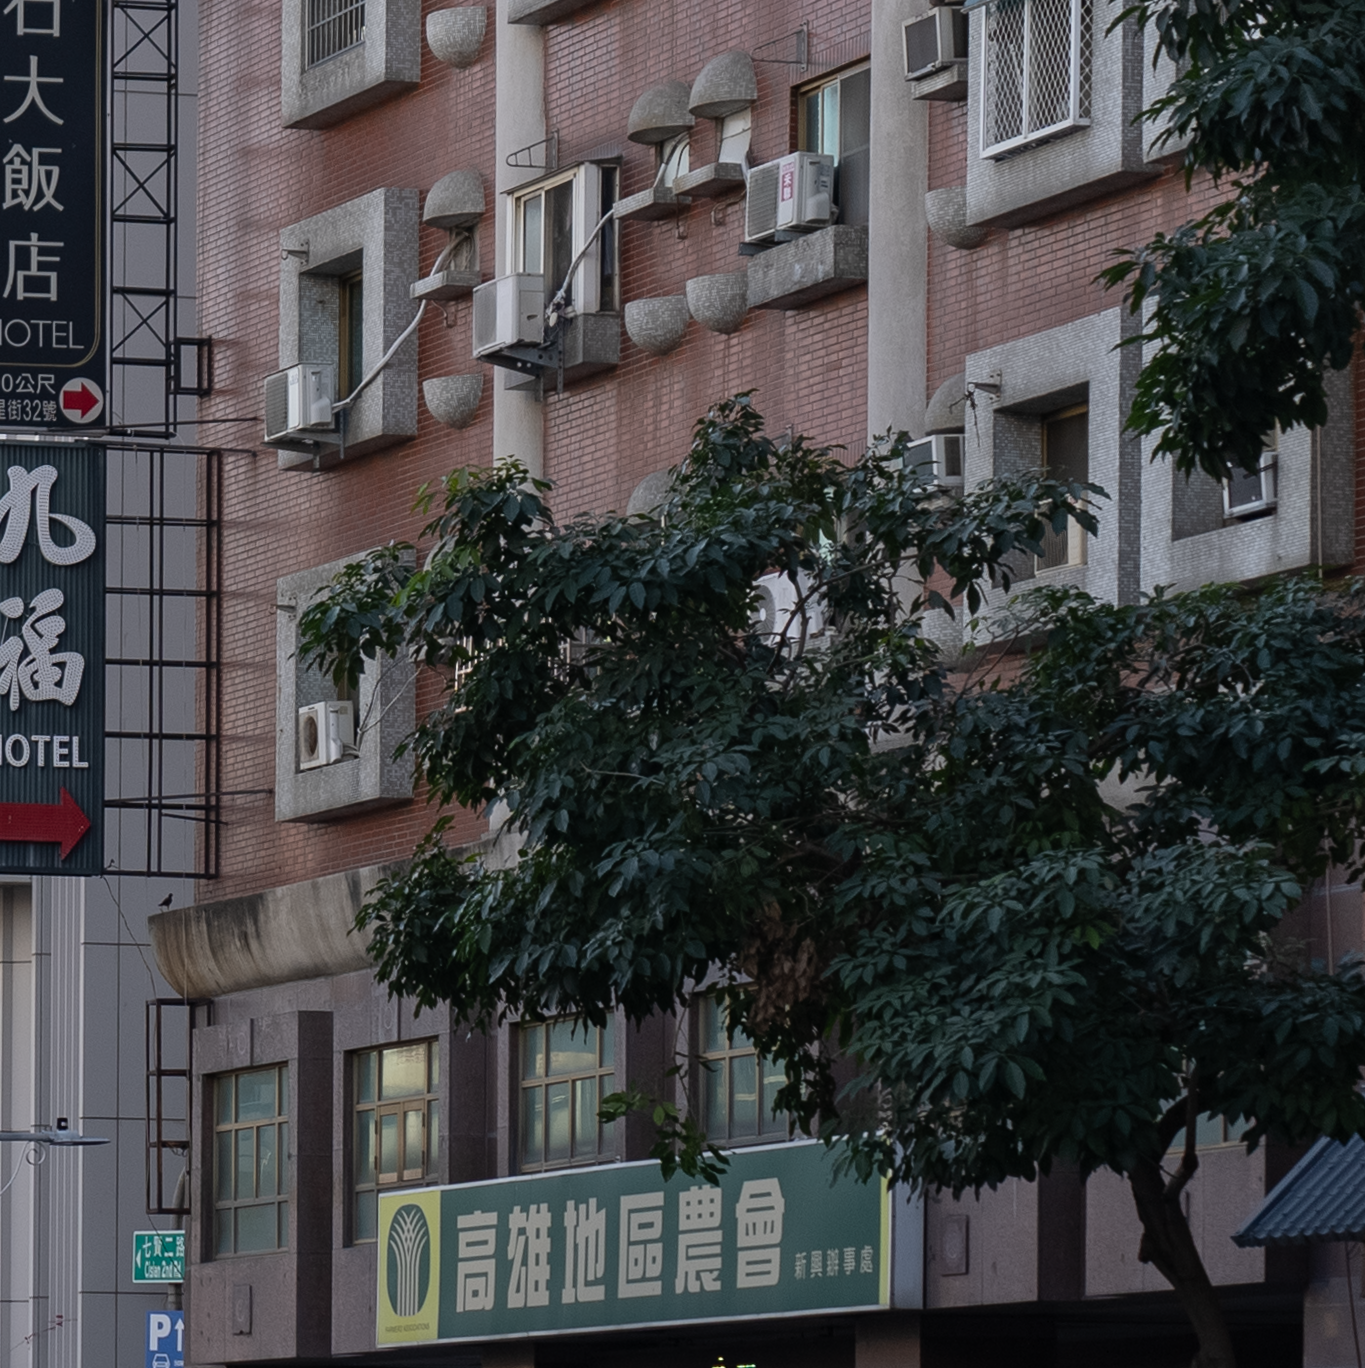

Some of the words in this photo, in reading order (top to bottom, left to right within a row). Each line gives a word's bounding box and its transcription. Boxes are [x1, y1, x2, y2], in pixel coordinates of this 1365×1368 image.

[142, 1236, 185, 1258] 七賢二路
[456, 1177, 785, 1313] 高雄地區農會
[795, 1245, 875, 1280] 新興辦事處
[150, 1315, 171, 1351] P
